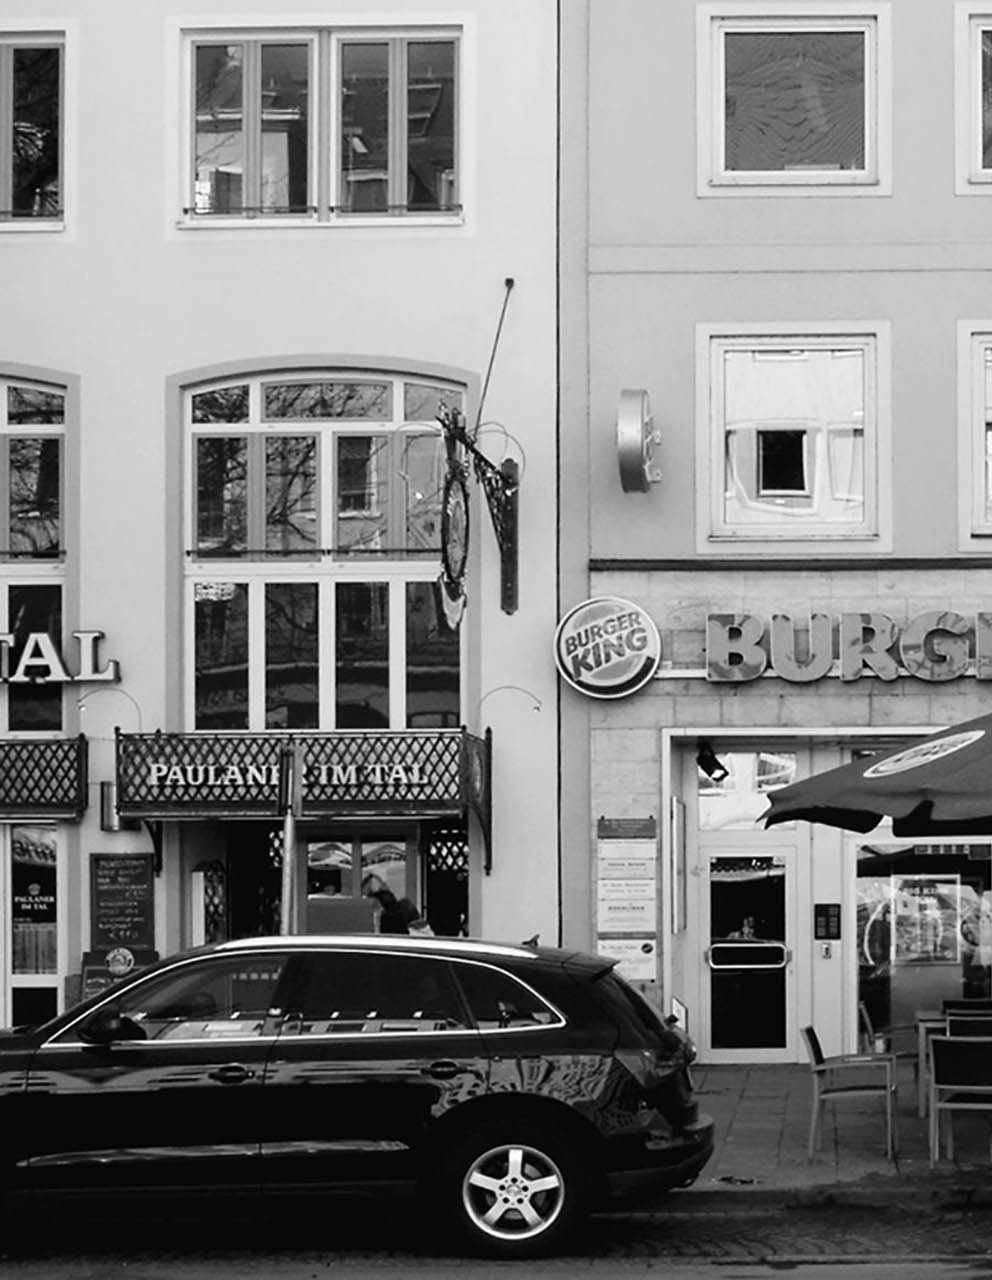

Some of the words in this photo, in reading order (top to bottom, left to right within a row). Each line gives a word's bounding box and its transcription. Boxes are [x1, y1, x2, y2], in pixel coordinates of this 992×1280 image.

[564, 612, 643, 657] BURGER
[571, 626, 648, 680] KING
[319, 764, 358, 784] IM
[367, 762, 429, 785] TAL
